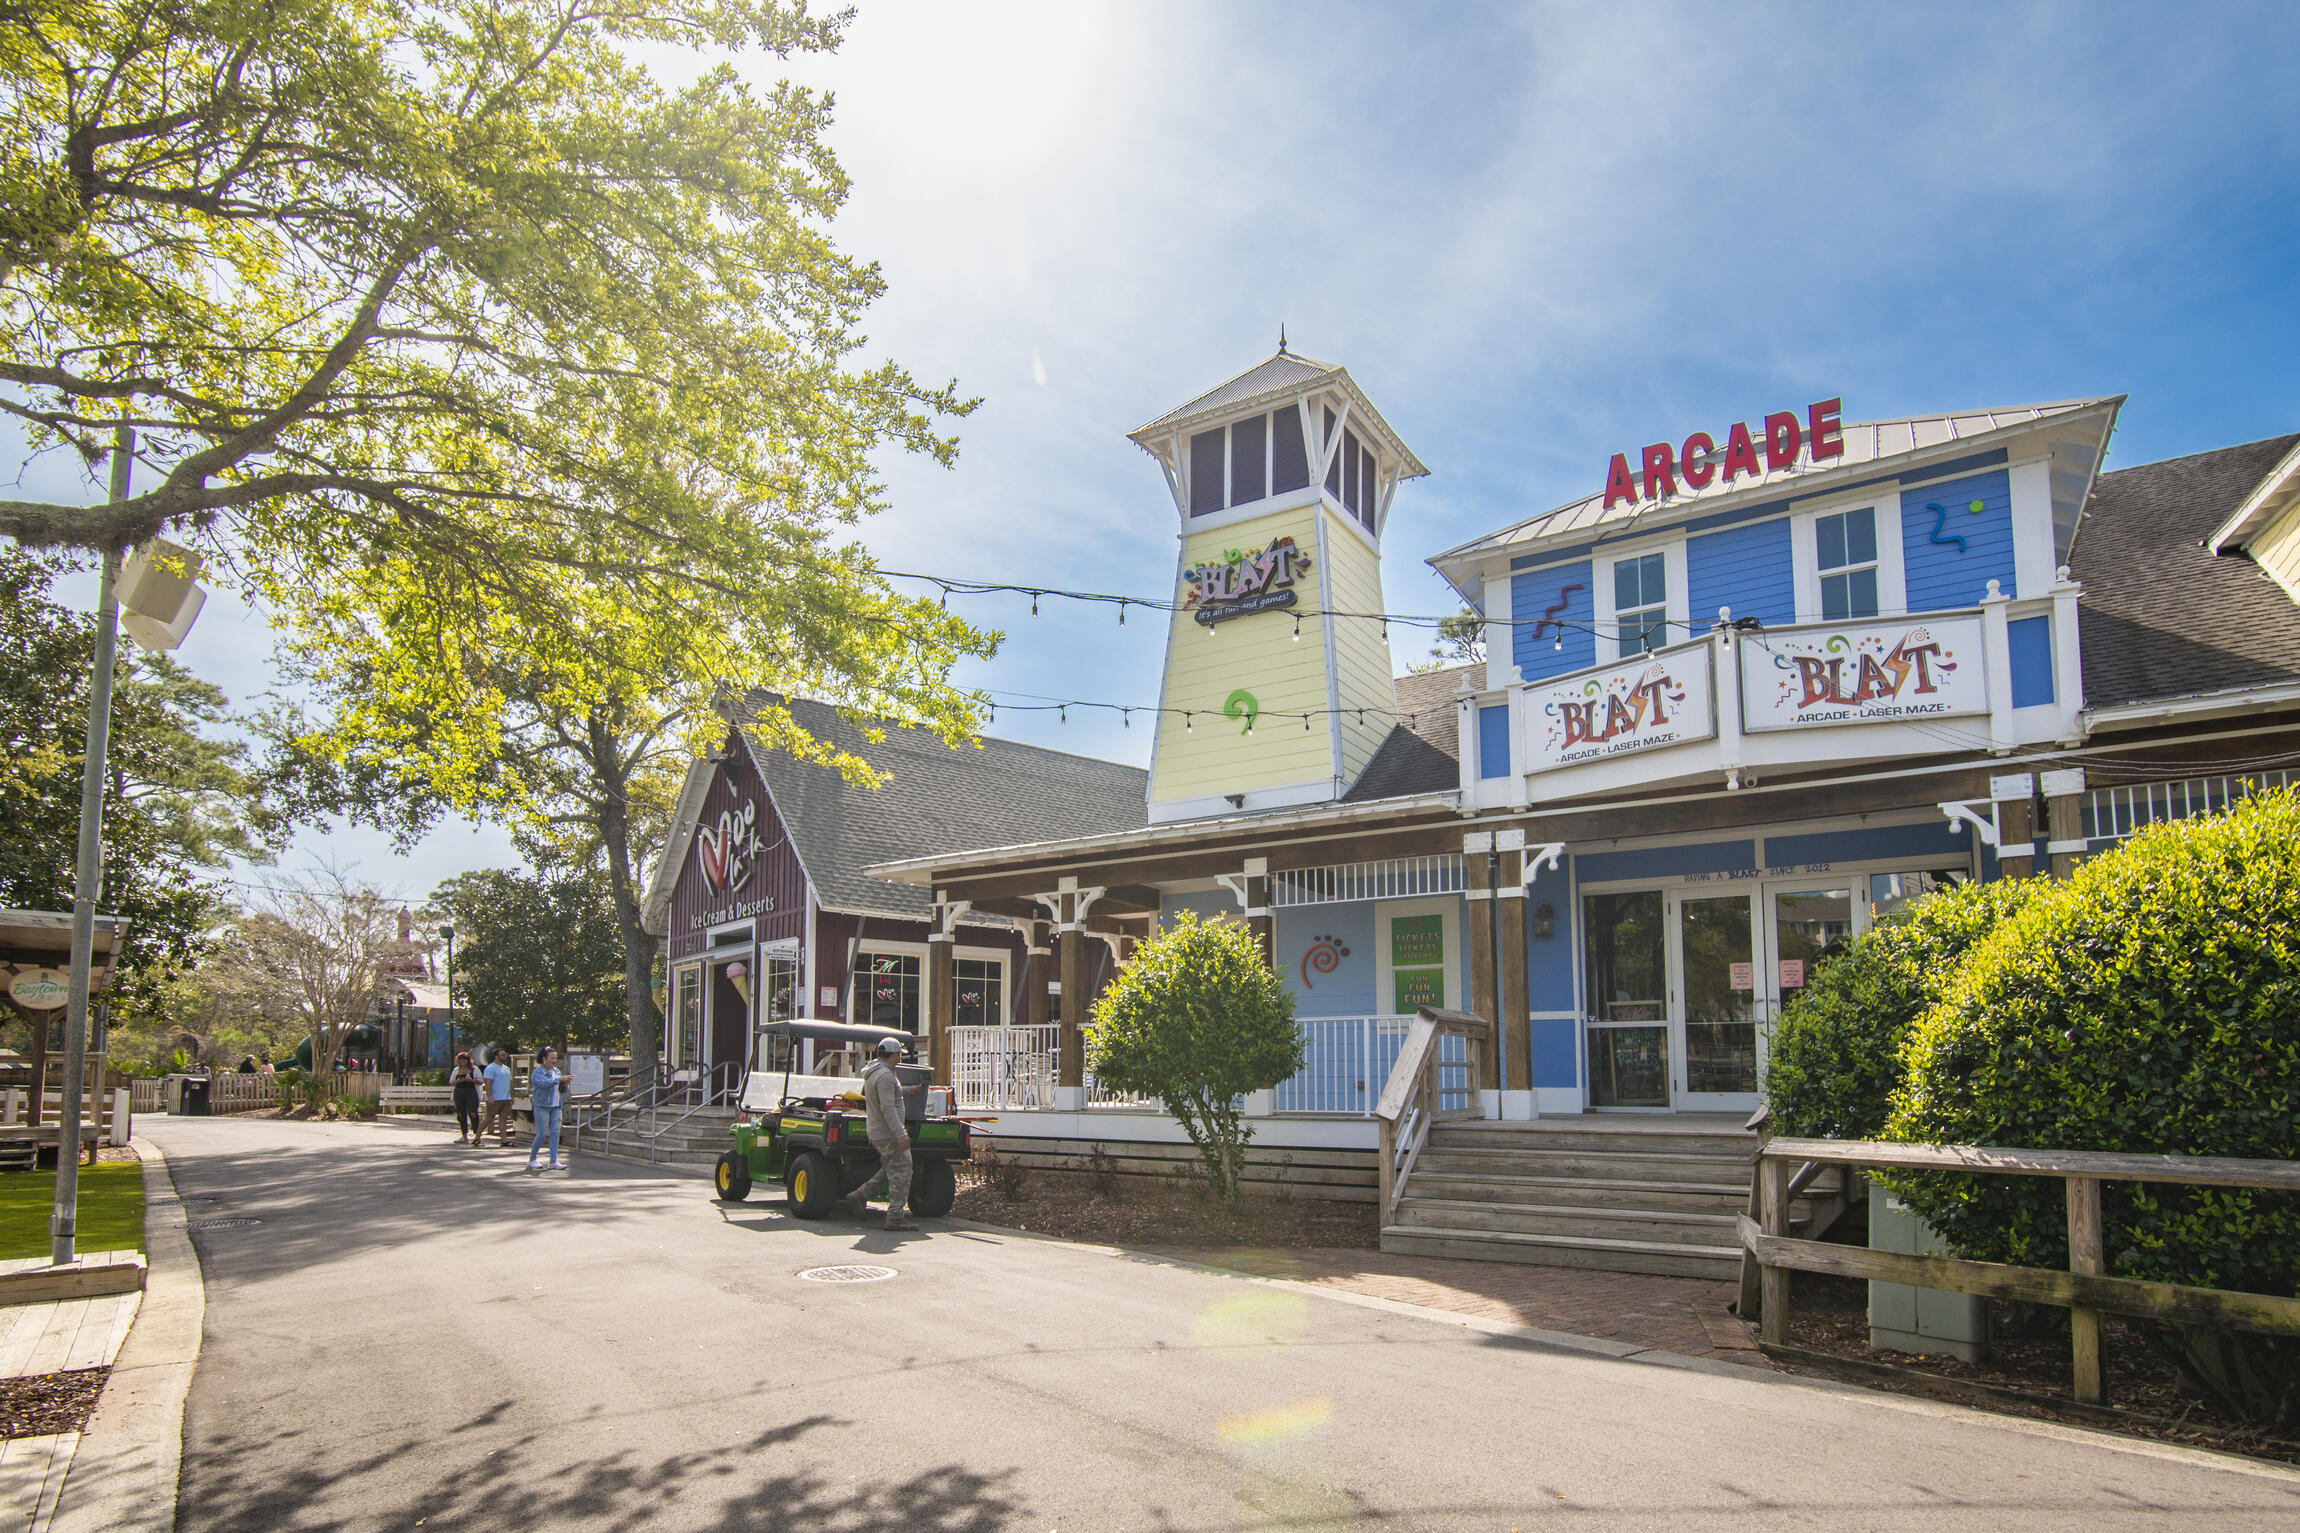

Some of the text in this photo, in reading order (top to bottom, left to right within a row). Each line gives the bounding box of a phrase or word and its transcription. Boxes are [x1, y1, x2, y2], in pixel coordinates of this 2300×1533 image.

[1603, 397, 1845, 510] ARCADE
[1197, 537, 1298, 607] BLAST
[1260, 591, 1290, 608] games!
[1793, 632, 1941, 709] BLAST
[1558, 669, 1672, 751] BLAST
[1797, 703, 1945, 723] ARCADE LASER MAZE
[1560, 732, 1676, 763] ARCADE LASER MAZE
[1804, 863, 1832, 873] 2012
[691, 895, 775, 929] Ice Cream & Desserts
[1395, 932, 1440, 944] TICKETS
[1403, 992, 1436, 1006] FUN!
[1408, 983, 1431, 992] FUN
